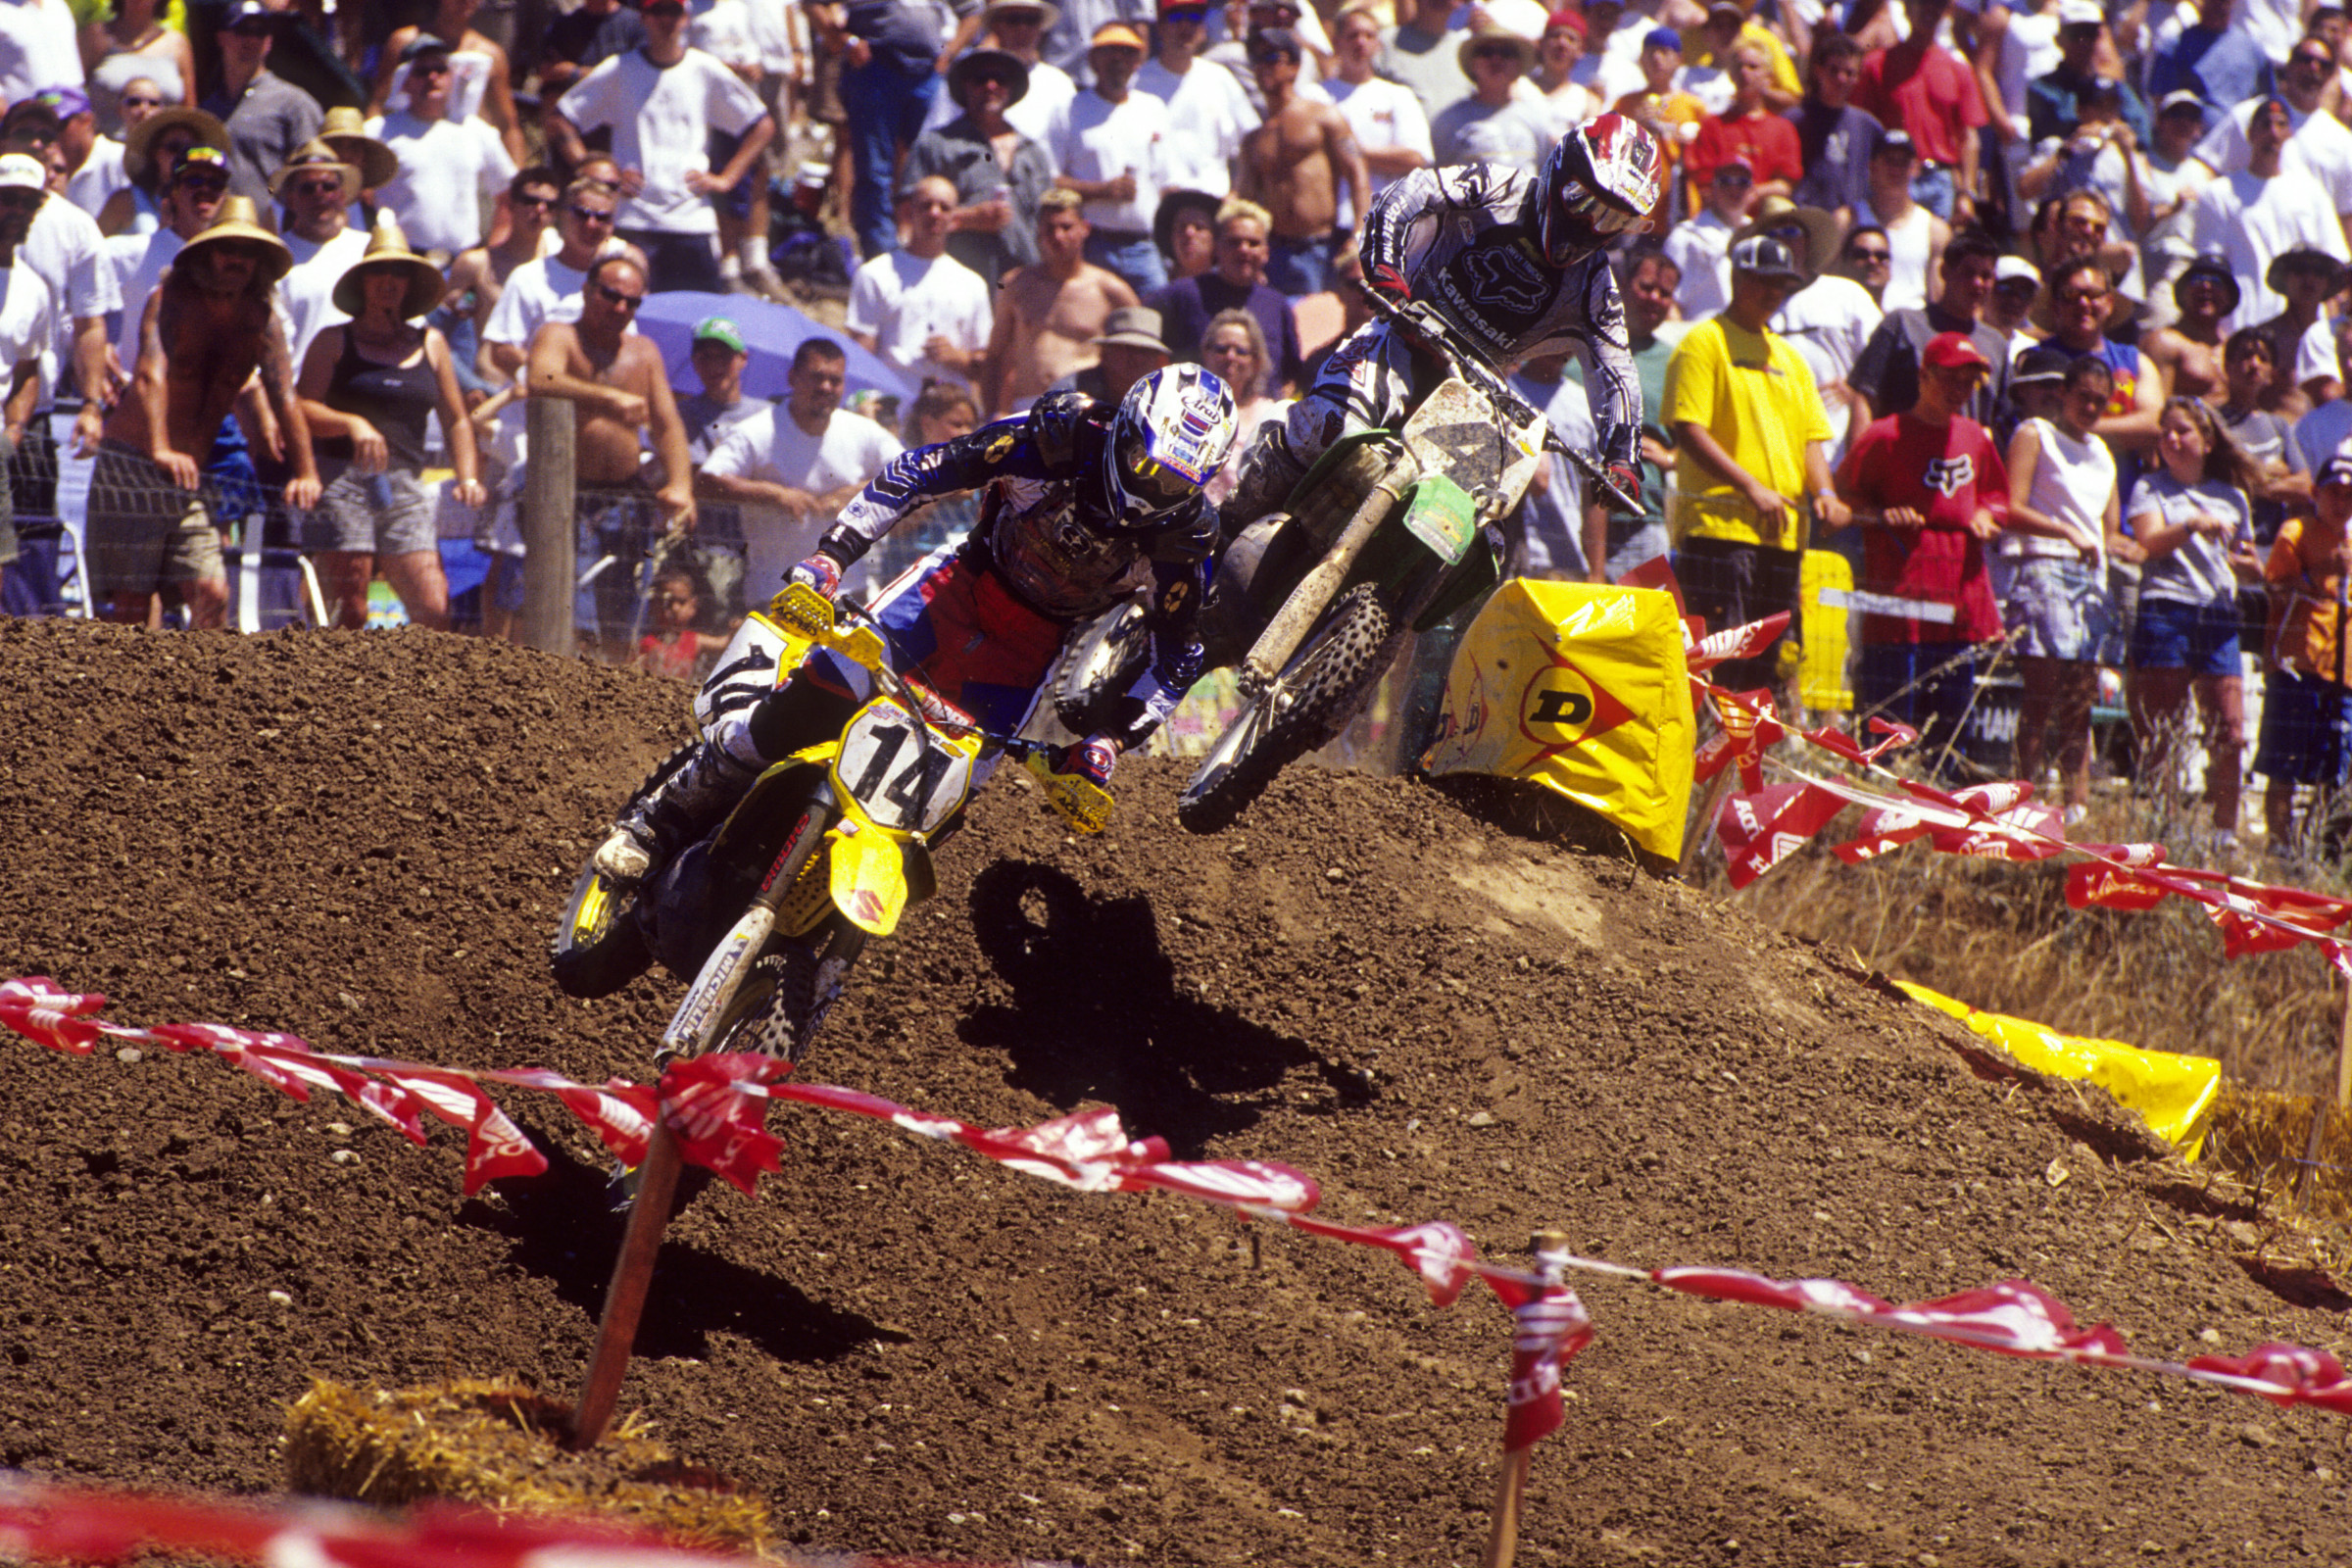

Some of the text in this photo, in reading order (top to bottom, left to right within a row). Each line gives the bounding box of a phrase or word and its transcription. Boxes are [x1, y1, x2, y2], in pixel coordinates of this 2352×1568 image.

[1437, 266, 1518, 351] Kawasaki
[1186, 397, 1218, 421] Arai
[1528, 689, 1592, 725] D
[852, 724, 954, 830] 14
[761, 813, 810, 892] SHOWA
[682, 953, 736, 1040] MICHELIN
